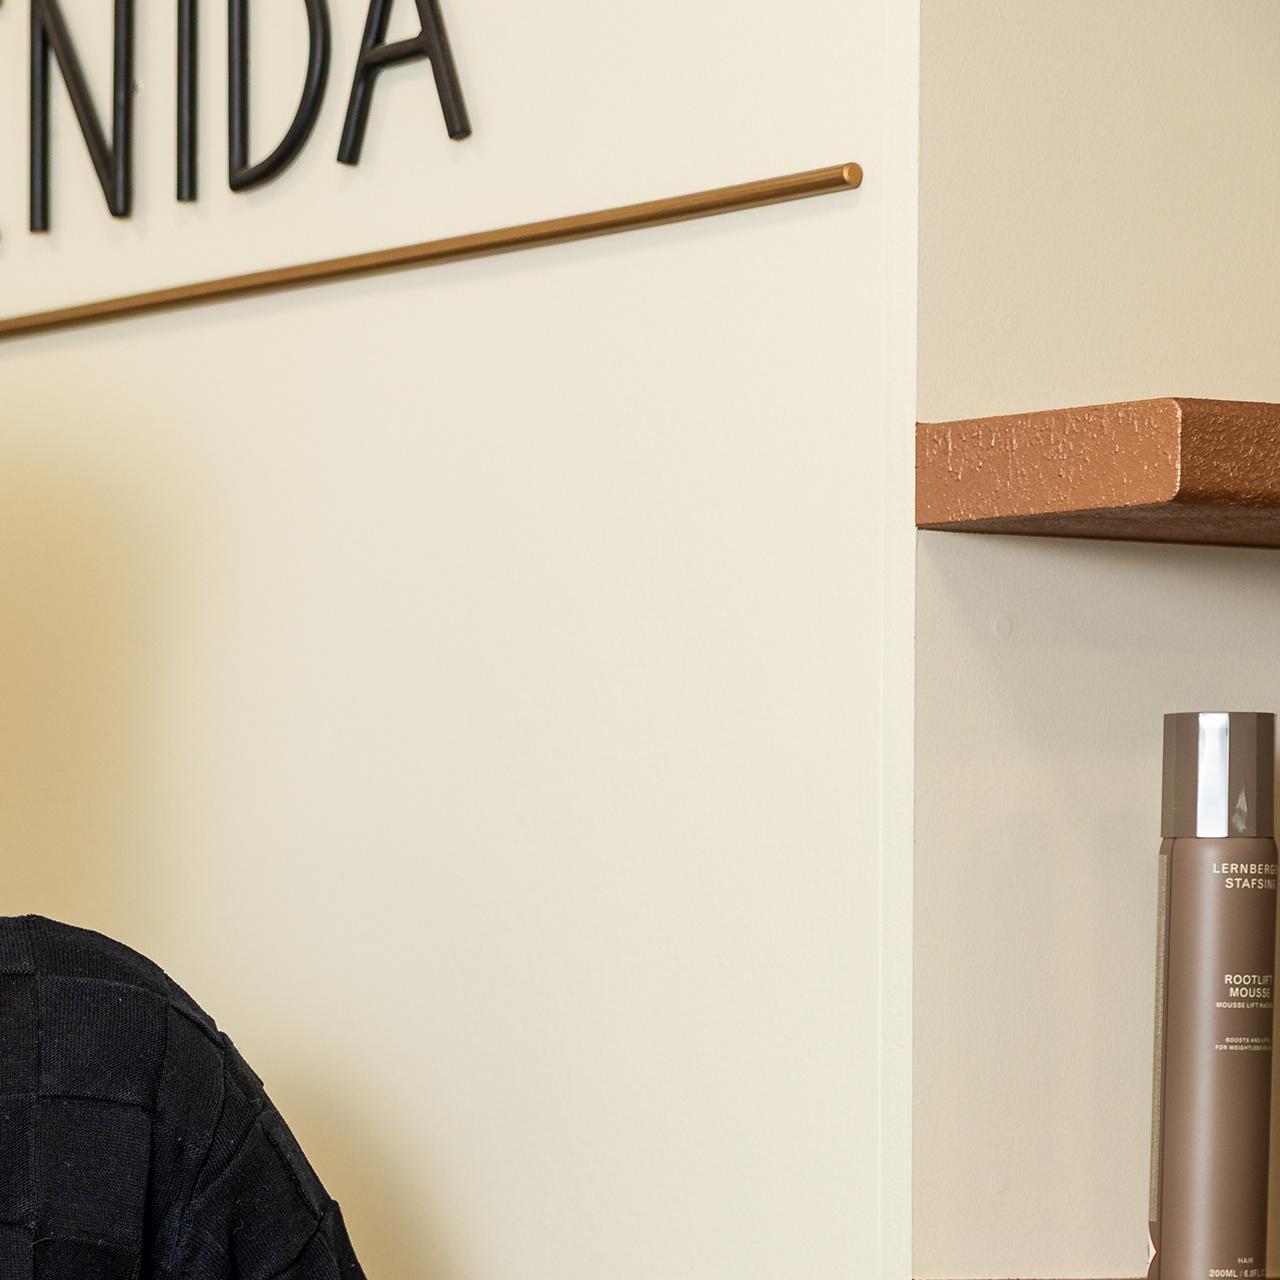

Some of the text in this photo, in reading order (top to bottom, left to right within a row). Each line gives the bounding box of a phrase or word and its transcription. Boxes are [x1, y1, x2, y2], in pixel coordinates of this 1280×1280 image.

[1224, 973, 1273, 985] ROOTLIFT
[1229, 986, 1271, 998] MOUSSE
[1215, 1001, 1246, 1009] MOUSSE
[1237, 1257, 1254, 1265] HAIR
[1209, 1268, 1239, 1278] 200ML
